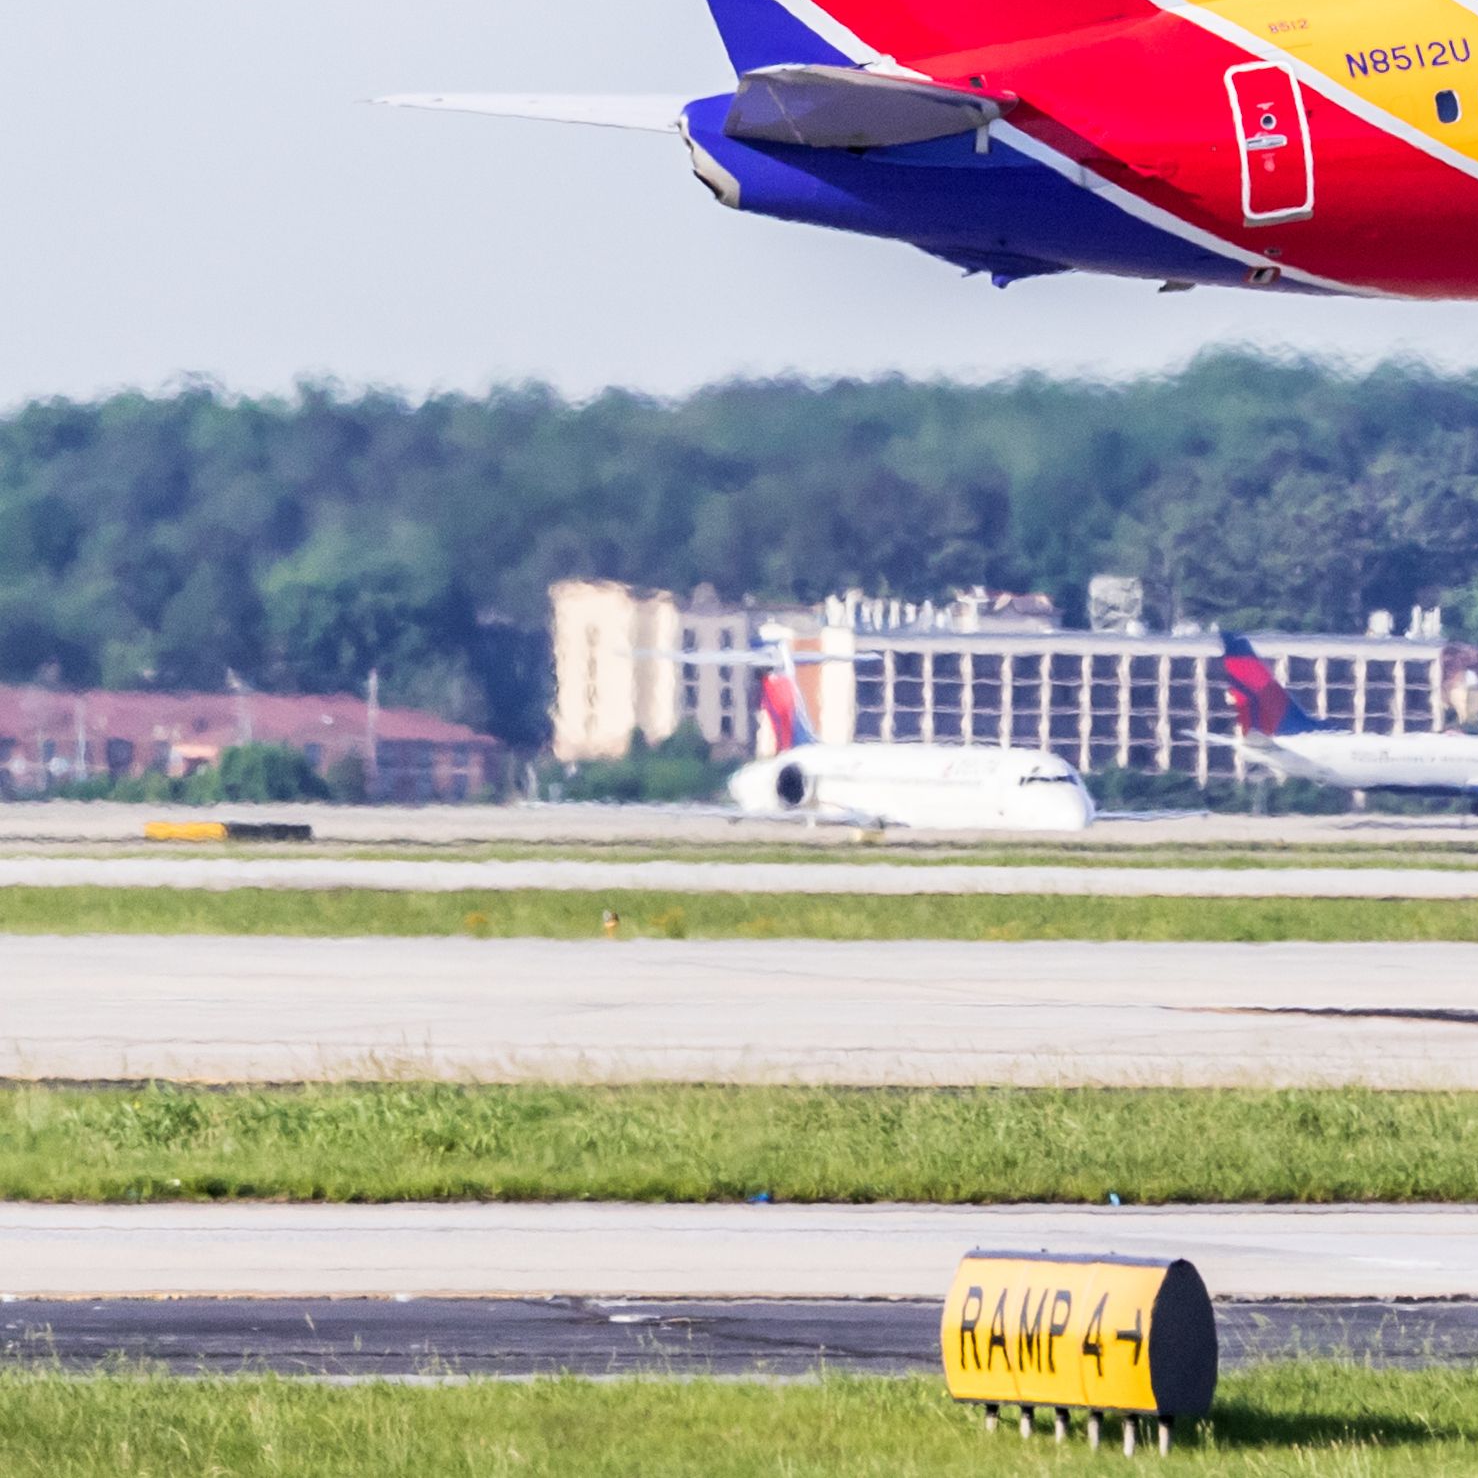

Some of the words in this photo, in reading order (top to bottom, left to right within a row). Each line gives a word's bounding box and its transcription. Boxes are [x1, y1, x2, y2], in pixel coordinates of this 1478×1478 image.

[1269, 18, 1309, 34] 8512
[1345, 38, 1470, 78] N8512U
[960, 1285, 1072, 1374] RAMP
[1081, 1291, 1109, 1377] 4
